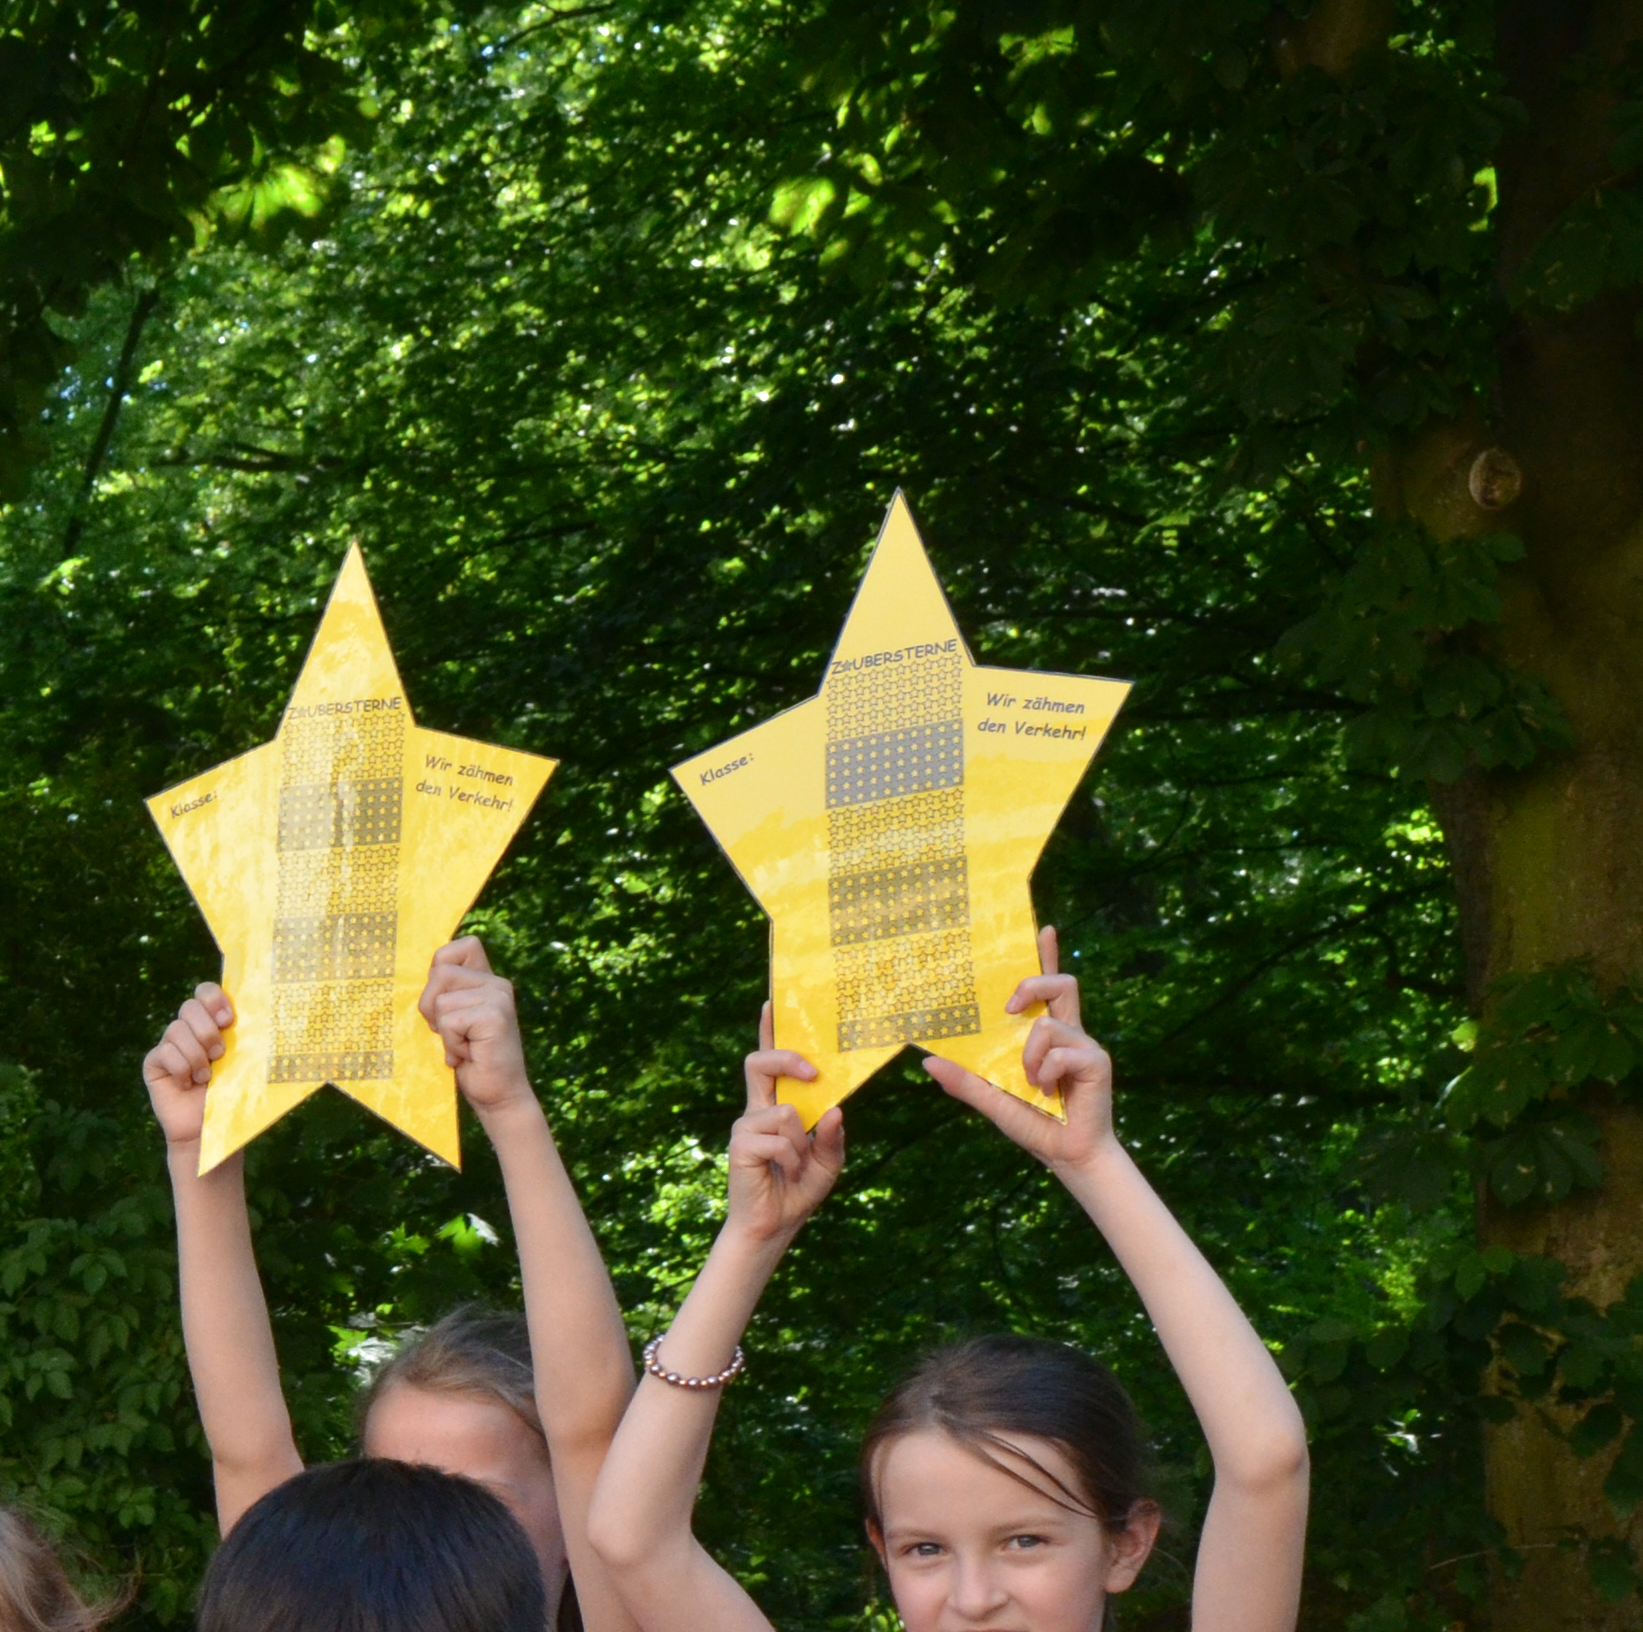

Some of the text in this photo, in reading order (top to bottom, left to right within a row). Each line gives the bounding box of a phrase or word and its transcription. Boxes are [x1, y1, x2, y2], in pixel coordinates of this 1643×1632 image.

[831, 638, 958, 675] ZUBERSTERNE
[287, 696, 403, 721] ZUBERSTERNE
[986, 692, 1085, 714] Wir zähmen
[977, 718, 1087, 741] den Verkehr!
[425, 754, 514, 787] Wir zähmen
[699, 752, 754, 786] Klasse:
[170, 790, 218, 819] Klasse:
[415, 780, 513, 812] den Verkehr!
